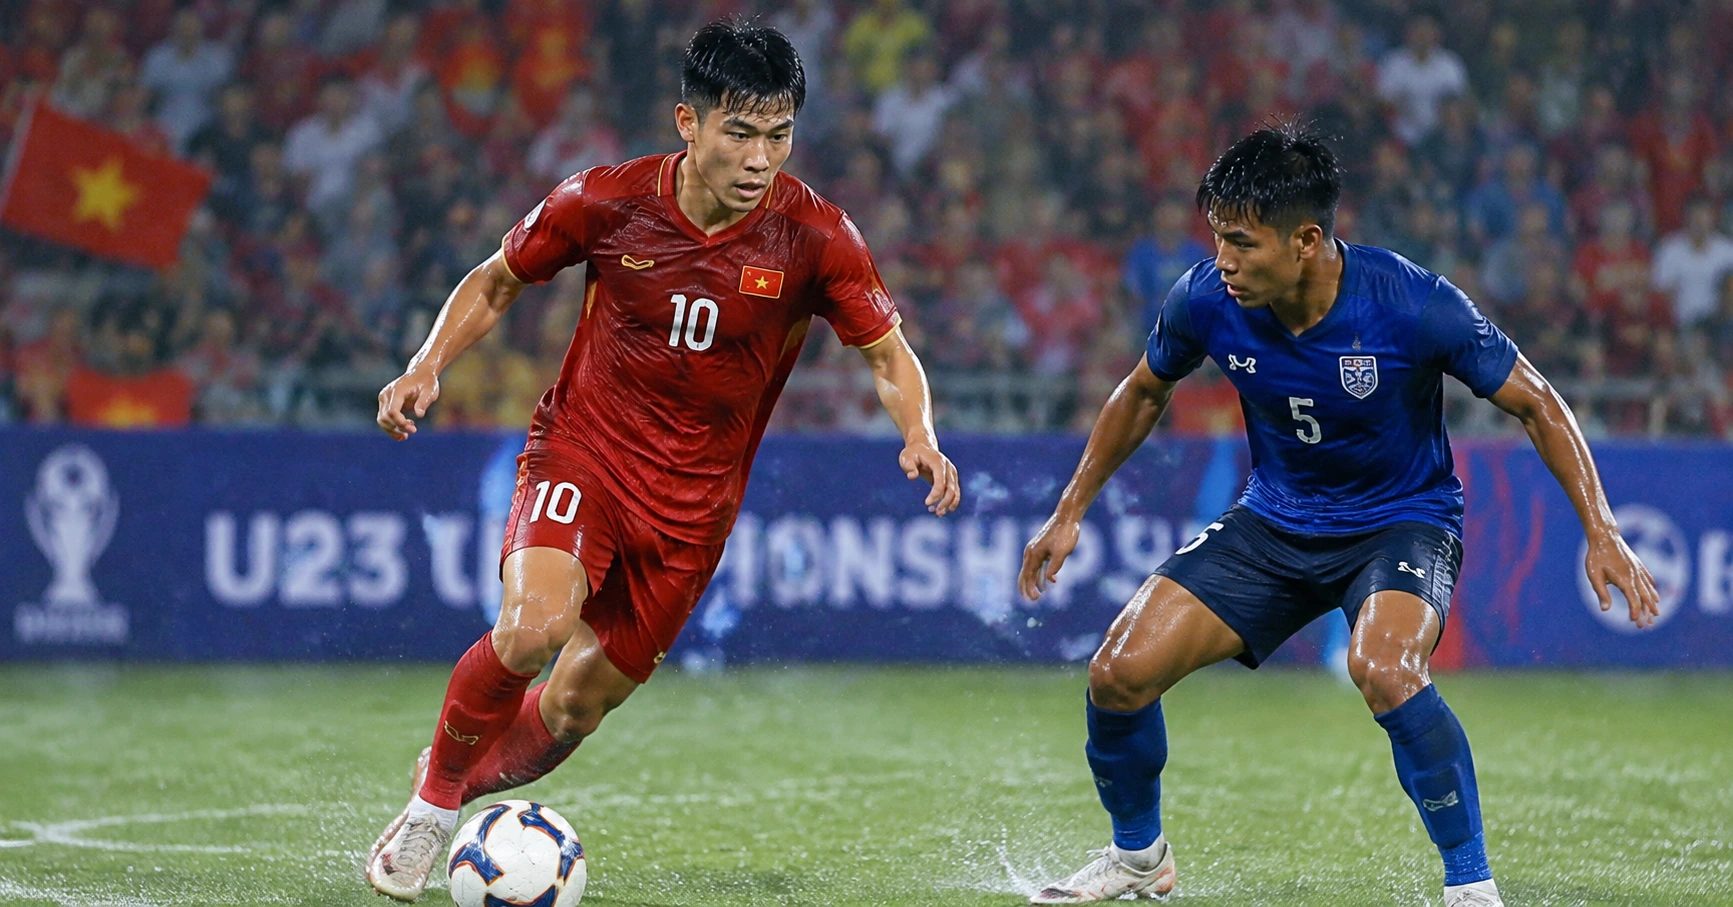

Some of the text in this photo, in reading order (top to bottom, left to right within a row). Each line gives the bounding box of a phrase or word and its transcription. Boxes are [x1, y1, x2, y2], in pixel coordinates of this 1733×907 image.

[668, 294, 719, 351] 10
[1288, 396, 1322, 444] 5
[529, 480, 582, 525] 10
[205, 512, 407, 606] U23
